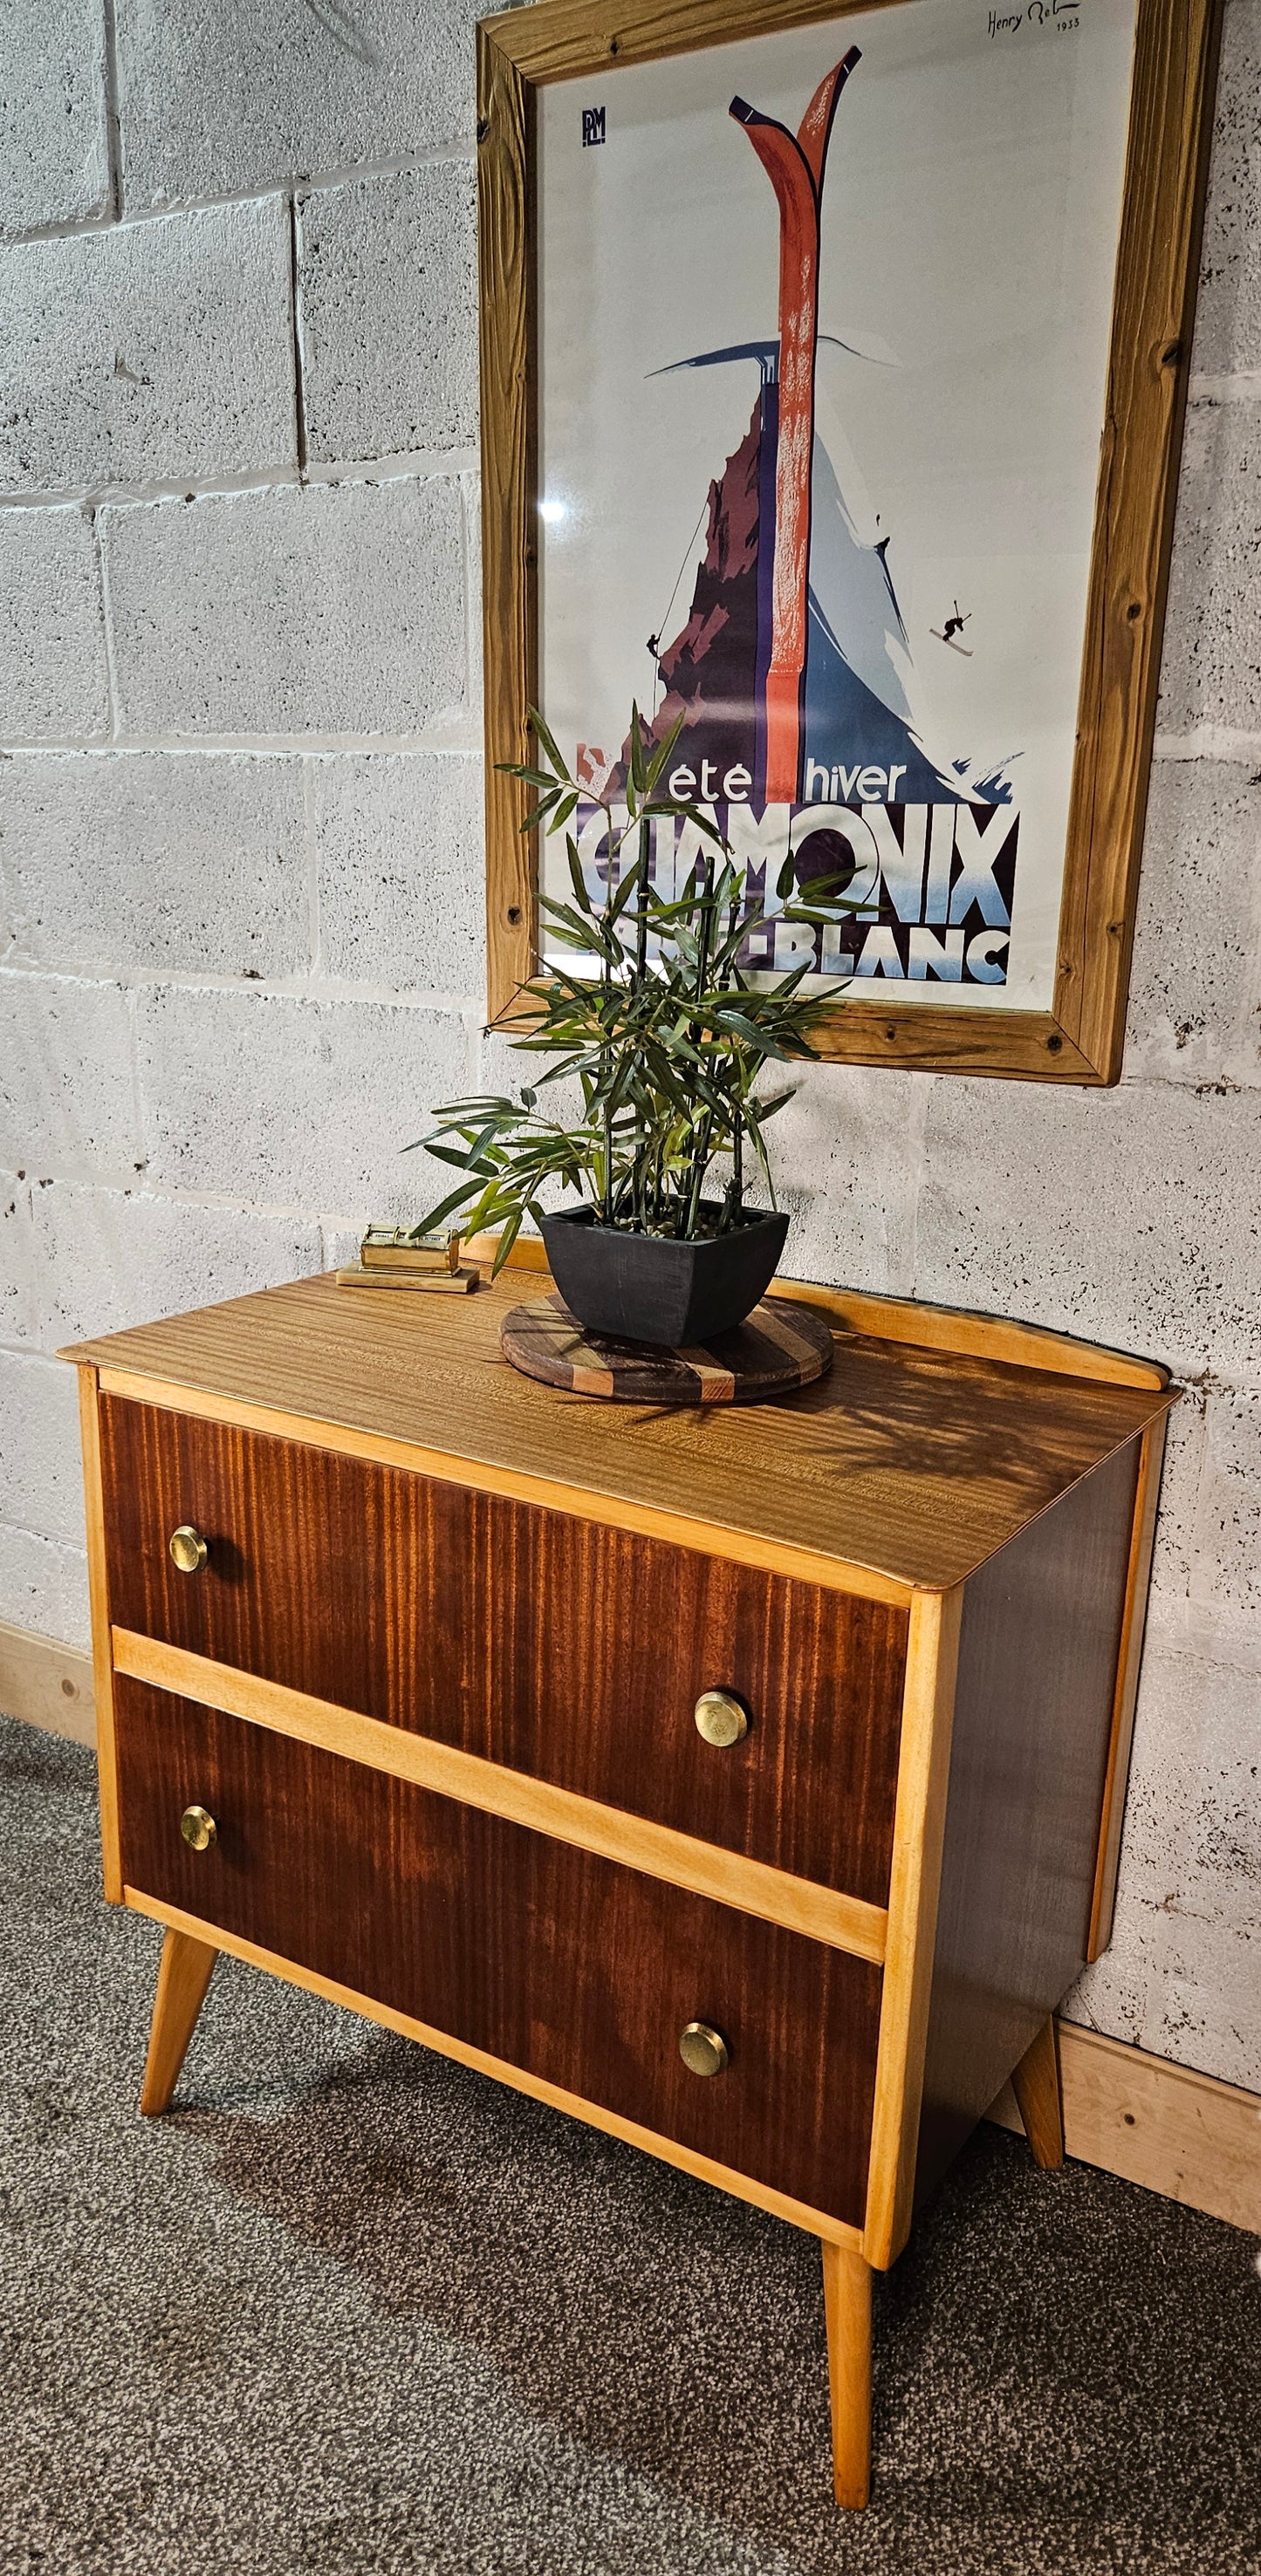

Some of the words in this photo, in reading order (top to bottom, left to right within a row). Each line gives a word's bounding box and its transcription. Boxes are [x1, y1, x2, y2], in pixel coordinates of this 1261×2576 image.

[988, 10, 1022, 38] Henry
[668, 759, 752, 802] été
[805, 758, 907, 802] hiver
